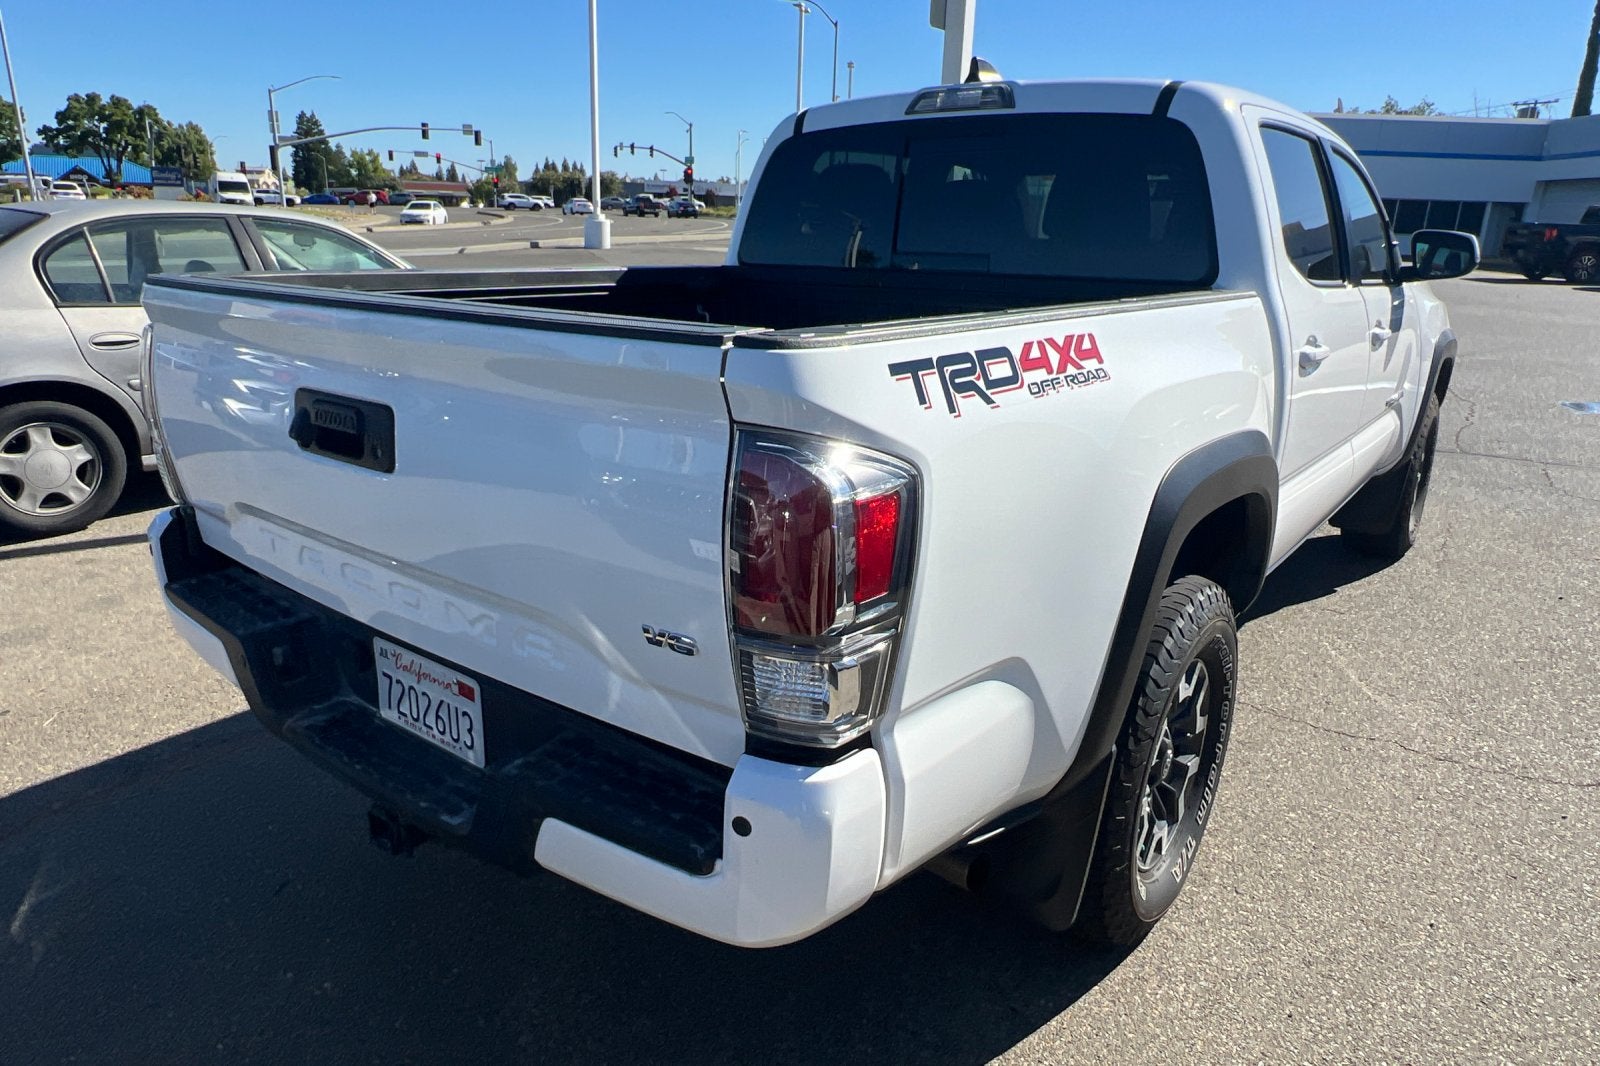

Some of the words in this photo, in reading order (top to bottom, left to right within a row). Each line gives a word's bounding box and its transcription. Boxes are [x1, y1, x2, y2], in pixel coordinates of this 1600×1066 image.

[888, 346, 1024, 418] TRD
[1019, 333, 1104, 375] 4X4
[1027, 375, 1062, 398] OFF
[1065, 367, 1110, 390] ROAD
[642, 623, 699, 656] V6
[395, 651, 452, 690] California
[382, 671, 474, 750] 72026U3
